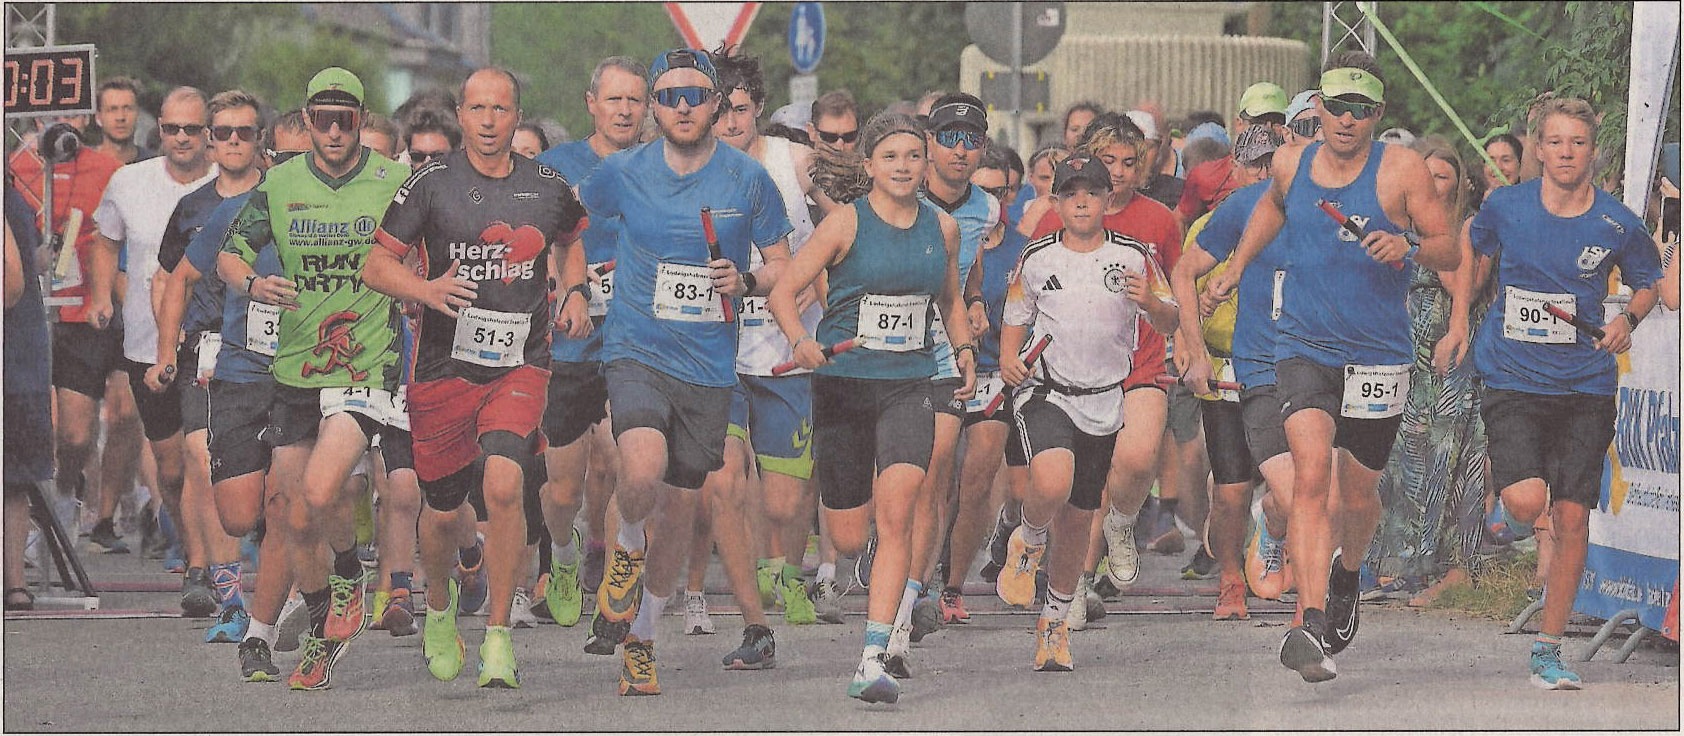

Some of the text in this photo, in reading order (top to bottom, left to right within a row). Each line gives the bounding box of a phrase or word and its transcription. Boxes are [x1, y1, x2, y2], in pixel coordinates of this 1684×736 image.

[289, 218, 350, 233] Allianz
[450, 242, 513, 260] Herz-
[301, 254, 361, 273] RUN
[457, 261, 535, 281] schlag
[294, 273, 364, 294] DIRTY
[674, 282, 715, 302] 83-1
[878, 312, 913, 330] 87-1
[473, 327, 515, 347] 51-3
[1361, 382, 1399, 399] 95-1
